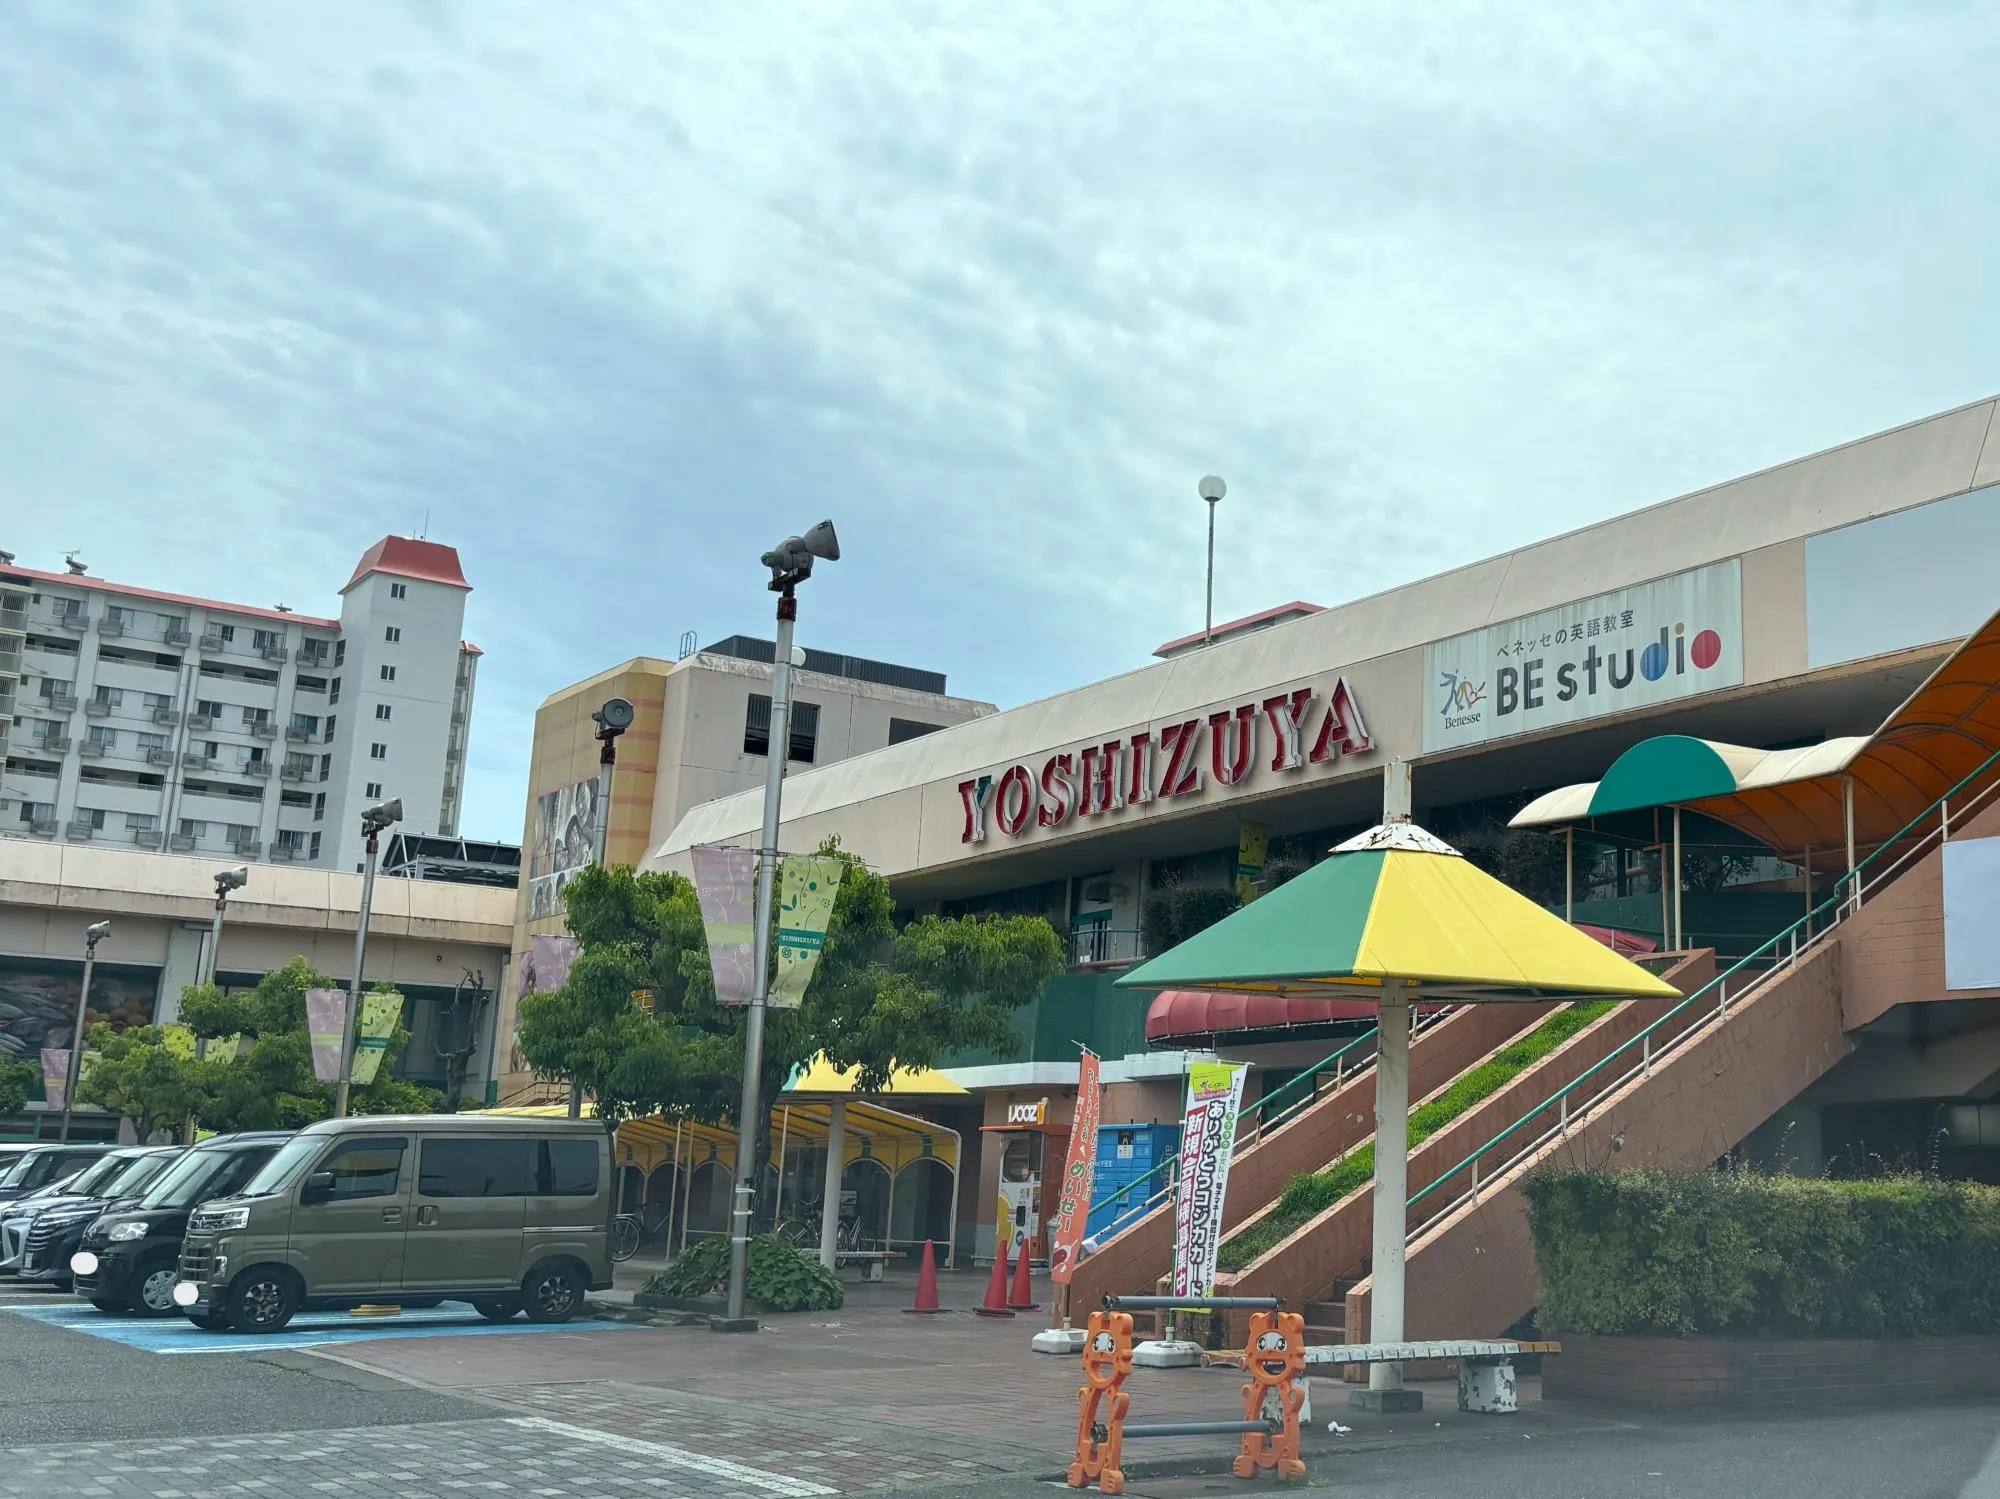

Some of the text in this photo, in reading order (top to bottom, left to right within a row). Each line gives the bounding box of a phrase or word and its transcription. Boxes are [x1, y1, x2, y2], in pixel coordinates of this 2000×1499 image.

[1496, 609, 1635, 657] ベネッセの英語教室
[1496, 622, 1722, 717] BE studio
[957, 676, 1375, 845] YOSHIZUYA
[1444, 711, 1482, 730] Benesse
[781, 935, 821, 944] YOSHIZUYA
[1176, 1112, 1204, 1296] 新規会員様募集中
[1189, 1100, 1226, 1297] ありがとうコジカカード
